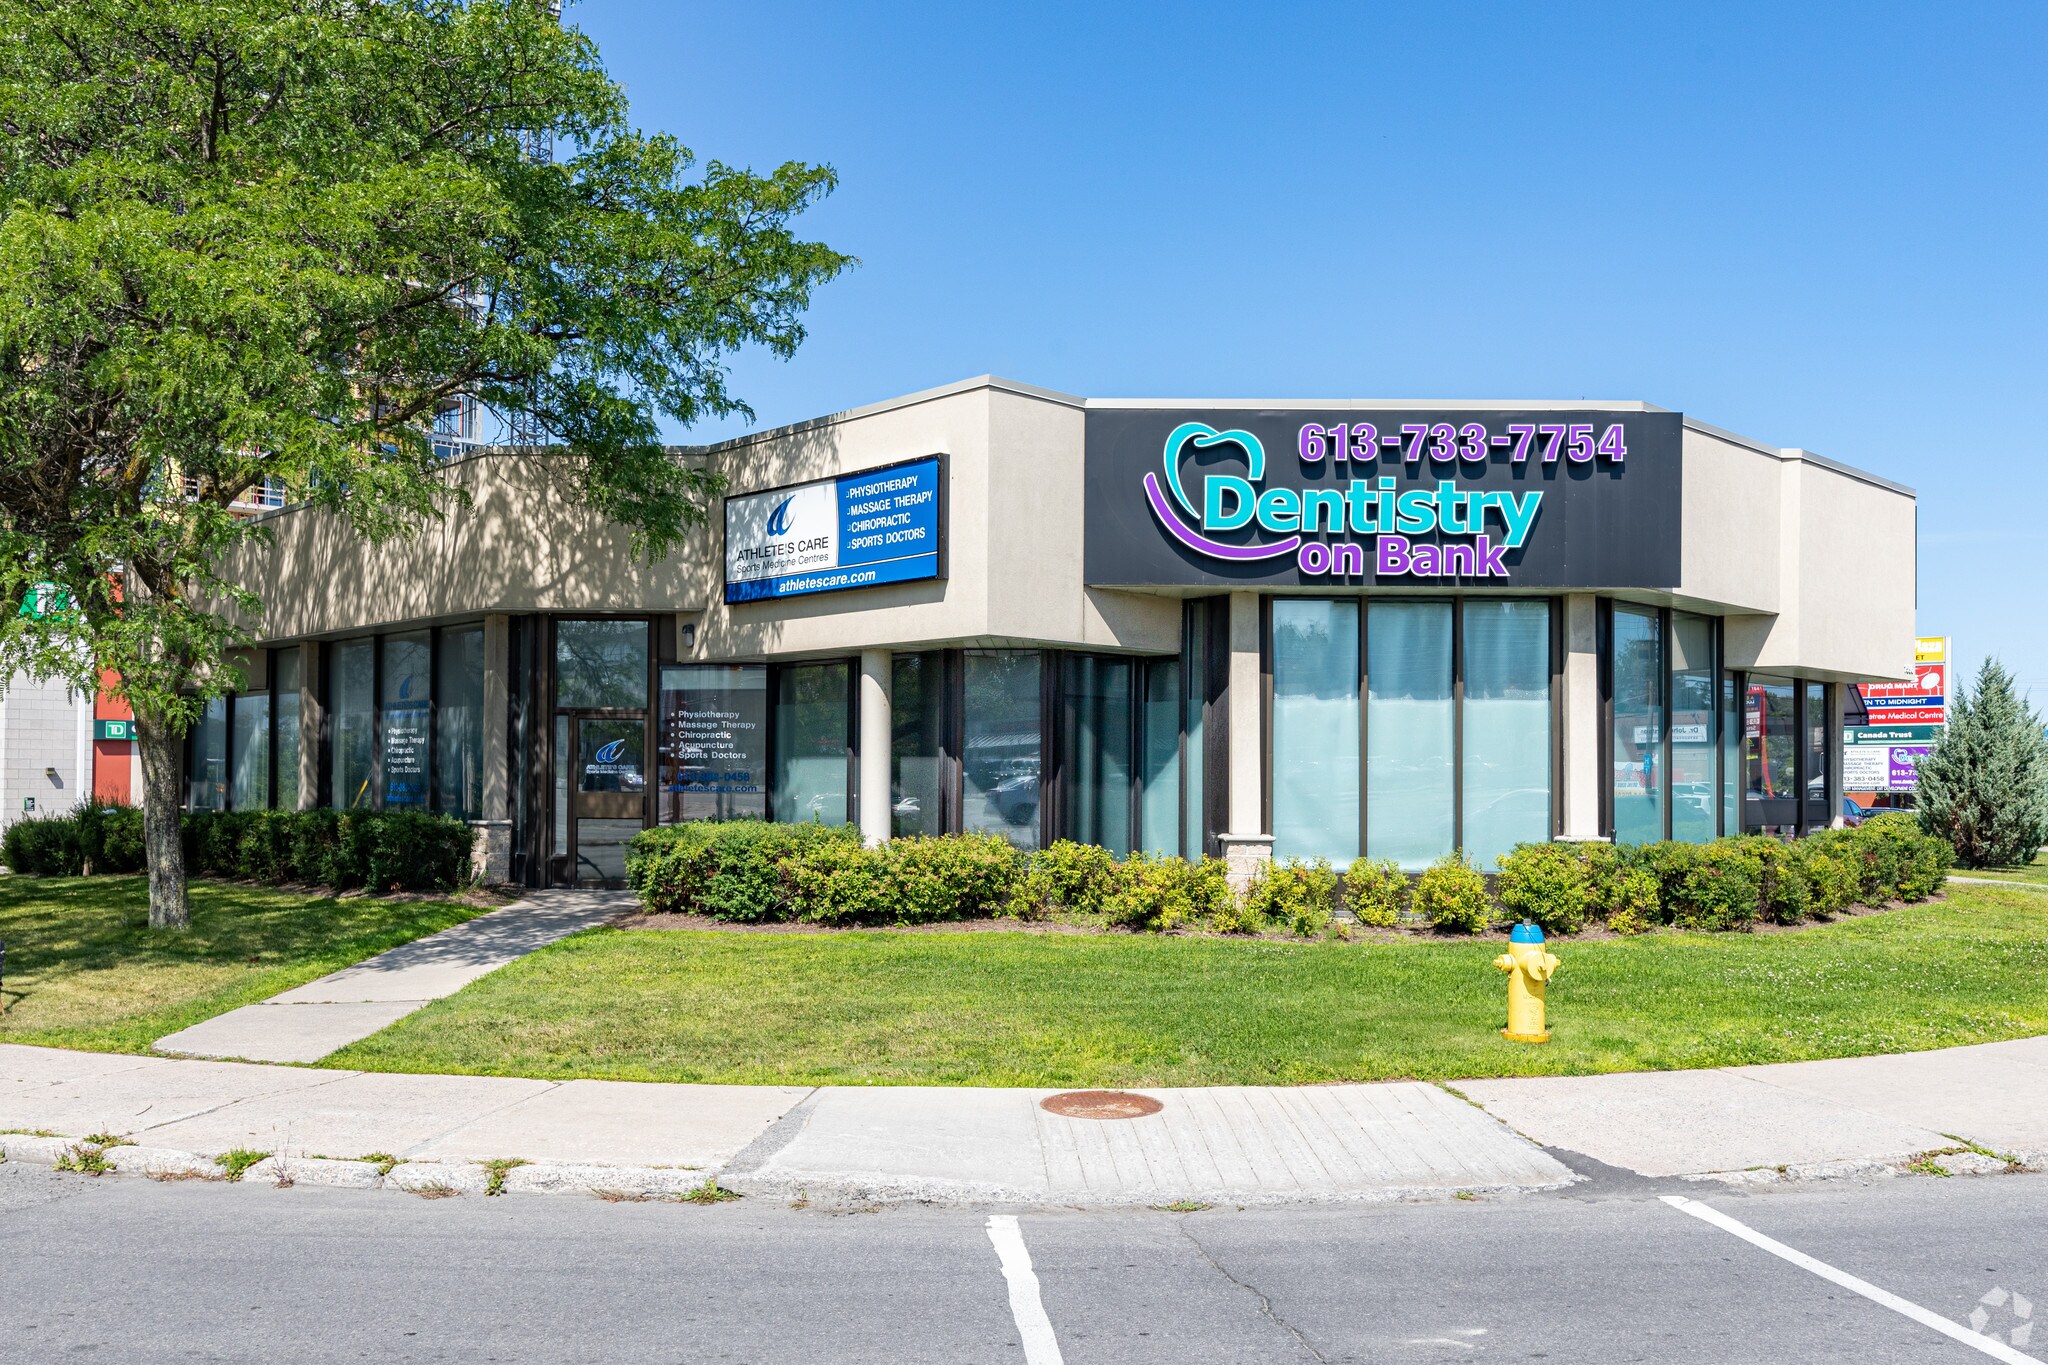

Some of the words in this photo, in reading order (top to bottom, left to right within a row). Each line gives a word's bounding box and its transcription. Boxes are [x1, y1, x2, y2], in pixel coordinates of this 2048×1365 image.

[1299, 423, 1627, 463] 613-733-7754
[849, 475, 918, 499] PHYSIOTHERAPY
[850, 499, 891, 517] MASSAGE
[894, 490, 933, 508] THERAPY
[1203, 476, 1544, 549] Dentistry
[851, 512, 911, 533] CHIROPRACTIC
[736, 539, 795, 562] ATHLETE'S
[797, 536, 829, 553] CARE
[851, 531, 883, 550] SPORTS
[886, 527, 926, 543] DOCTORS
[736, 562, 761, 574] Sports
[762, 557, 796, 570] Medicine
[798, 553, 829, 566] Centres
[1299, 541, 1364, 576] on
[1376, 535, 1510, 577] Bank
[779, 570, 876, 593] athletescare.com
[678, 710, 740, 720] Physiotherapy
[678, 721, 718, 730] Massage
[721, 721, 756, 730] Therapy
[1918, 711, 1944, 719] Centre
[108, 724, 124, 735] TD
[678, 731, 732, 740] Chiropractic
[678, 741, 734, 750] Acupuncture
[678, 751, 708, 760] Sports
[711, 751, 747, 759] Doctors
